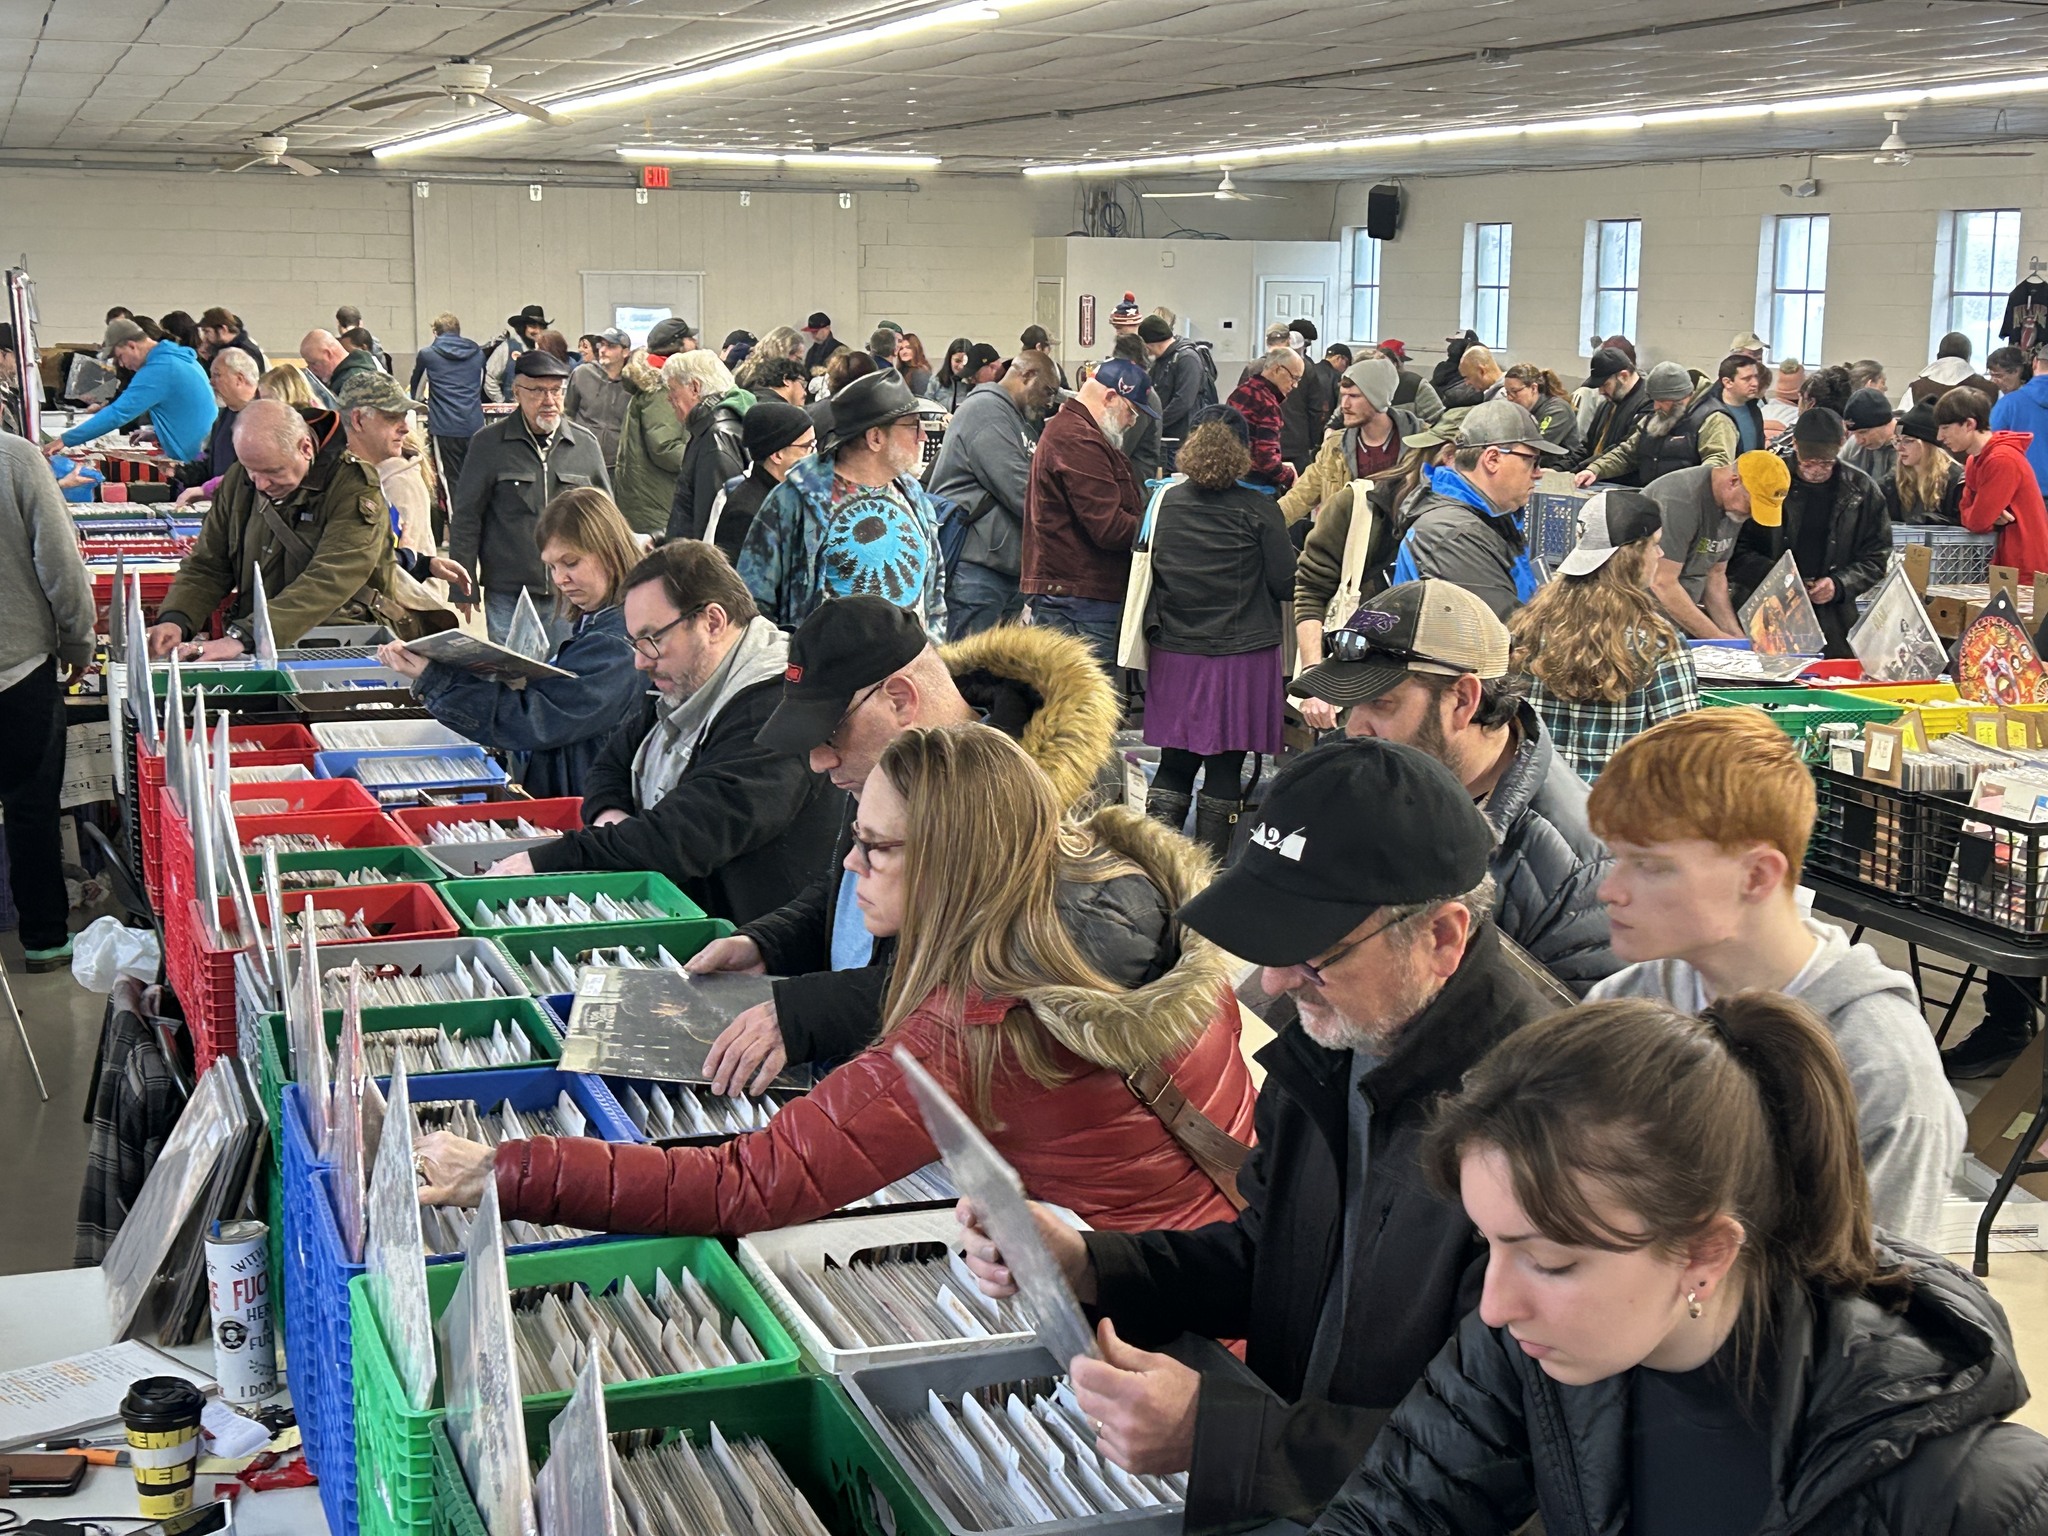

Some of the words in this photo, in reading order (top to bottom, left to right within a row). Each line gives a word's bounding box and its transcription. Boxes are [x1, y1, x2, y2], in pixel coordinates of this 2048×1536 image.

[645, 166, 669, 187] EXIT
[231, 1246, 265, 1273] WITH
[232, 1270, 269, 1311] FUC
